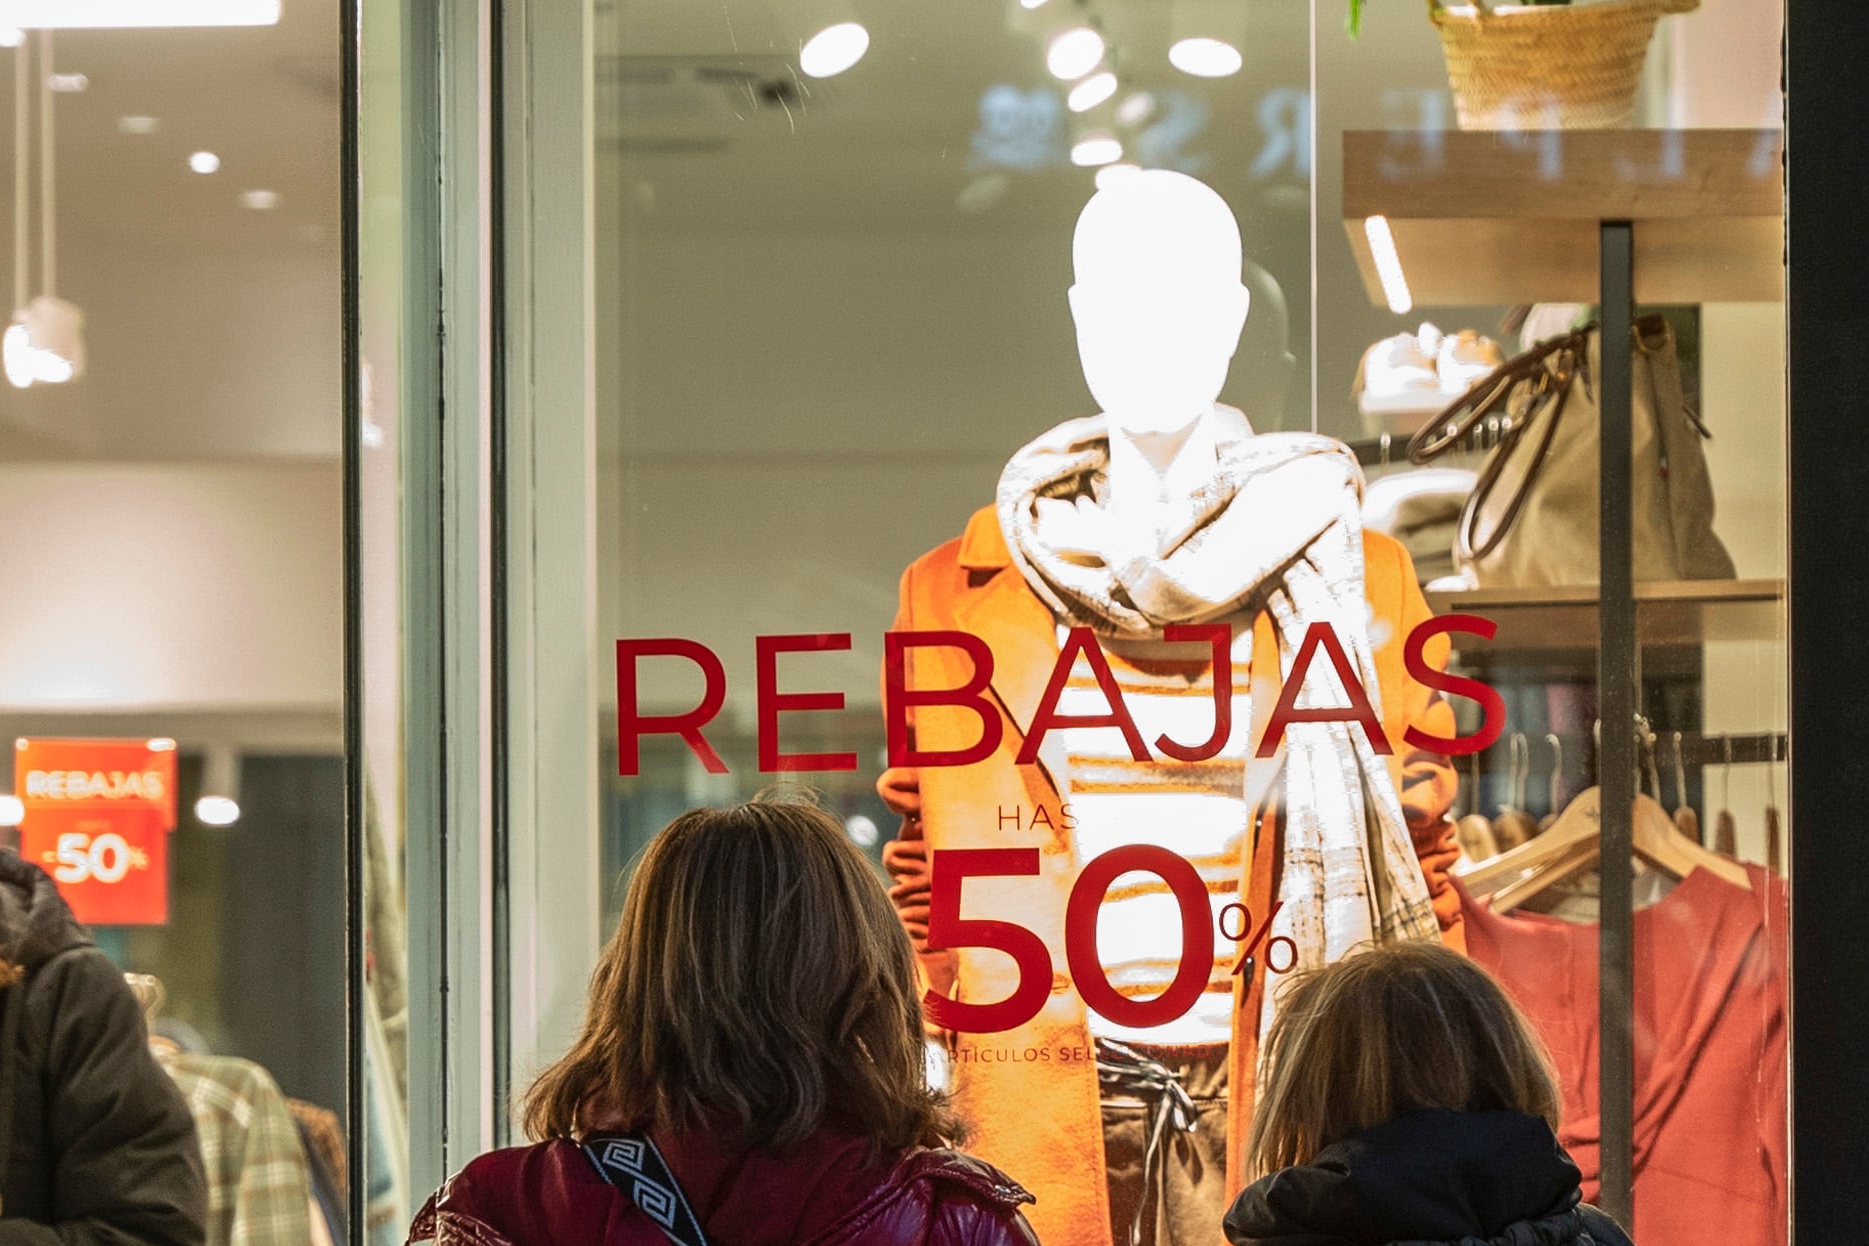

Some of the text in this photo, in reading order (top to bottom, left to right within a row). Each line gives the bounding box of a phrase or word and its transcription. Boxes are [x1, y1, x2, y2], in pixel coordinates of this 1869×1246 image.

[615, 613, 1508, 777] REBAJAS
[26, 769, 164, 800] REBAJAS
[42, 833, 149, 883] -50%
[924, 843, 1299, 1034] 50%
[945, 1044, 1051, 1064] RTÍCULOS
